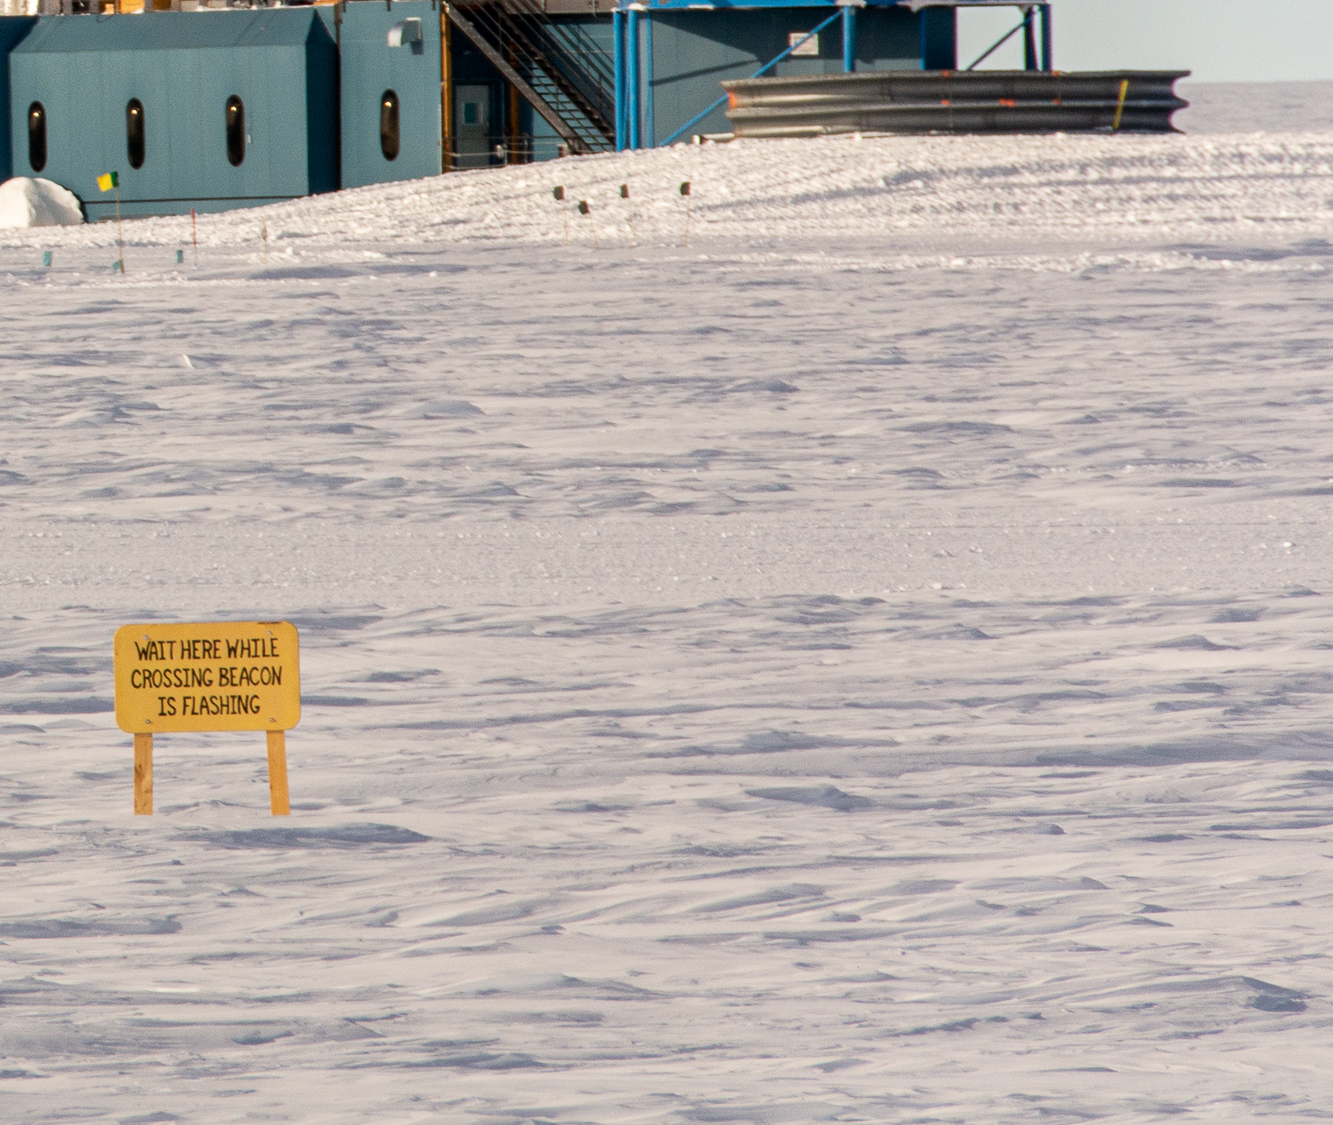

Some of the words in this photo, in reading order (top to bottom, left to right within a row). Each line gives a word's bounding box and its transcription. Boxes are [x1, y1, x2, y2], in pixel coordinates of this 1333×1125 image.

[135, 641, 176, 660] WAIT
[181, 639, 221, 659] HERE
[226, 638, 279, 658] WHILE
[131, 668, 213, 688] CROSSING
[219, 666, 282, 686] BEACON
[158, 697, 176, 716] IS
[183, 695, 260, 715] FLASHING
